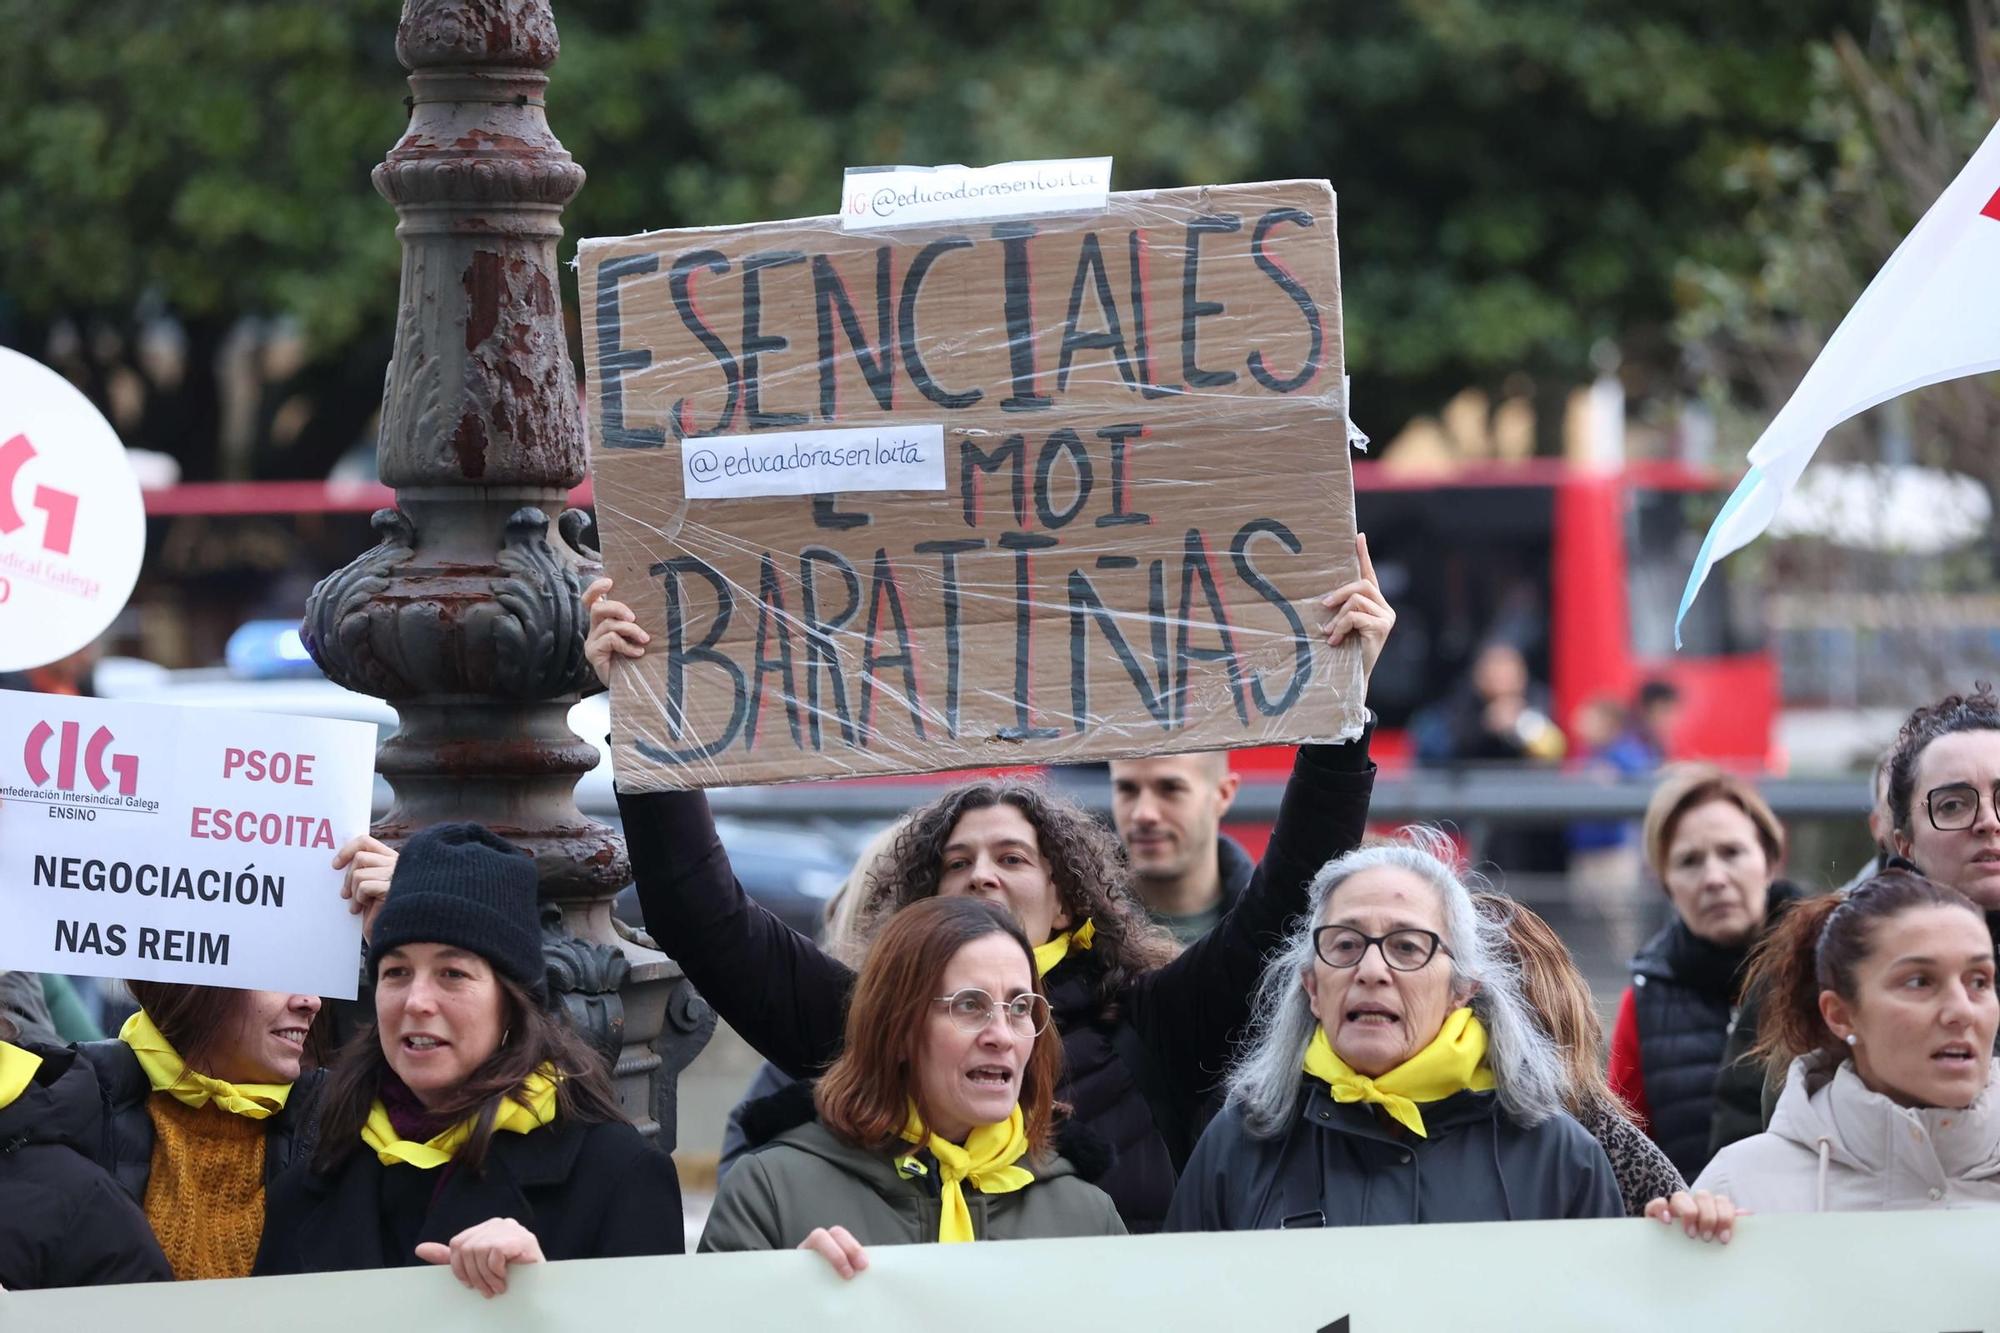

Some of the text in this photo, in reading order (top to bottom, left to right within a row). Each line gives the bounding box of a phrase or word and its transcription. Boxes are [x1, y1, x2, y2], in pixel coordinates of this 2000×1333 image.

[596, 207, 1327, 448] ESENCIALES
[689, 438, 926, 482] @educadorasenloita
[960, 423, 1157, 531] MOI
[634, 517, 1314, 765] BARATIÑAS
[23, 719, 139, 797] CIG
[222, 747, 316, 786] PSOE
[48, 805, 97, 822] ENSINO
[62, 790, 123, 806] Intersindical
[125, 796, 160, 811] Galega
[190, 806, 336, 850] ESCOITA
[33, 854, 285, 907] NEGOCIACIÓN
[54, 919, 231, 966] NAS REIM
